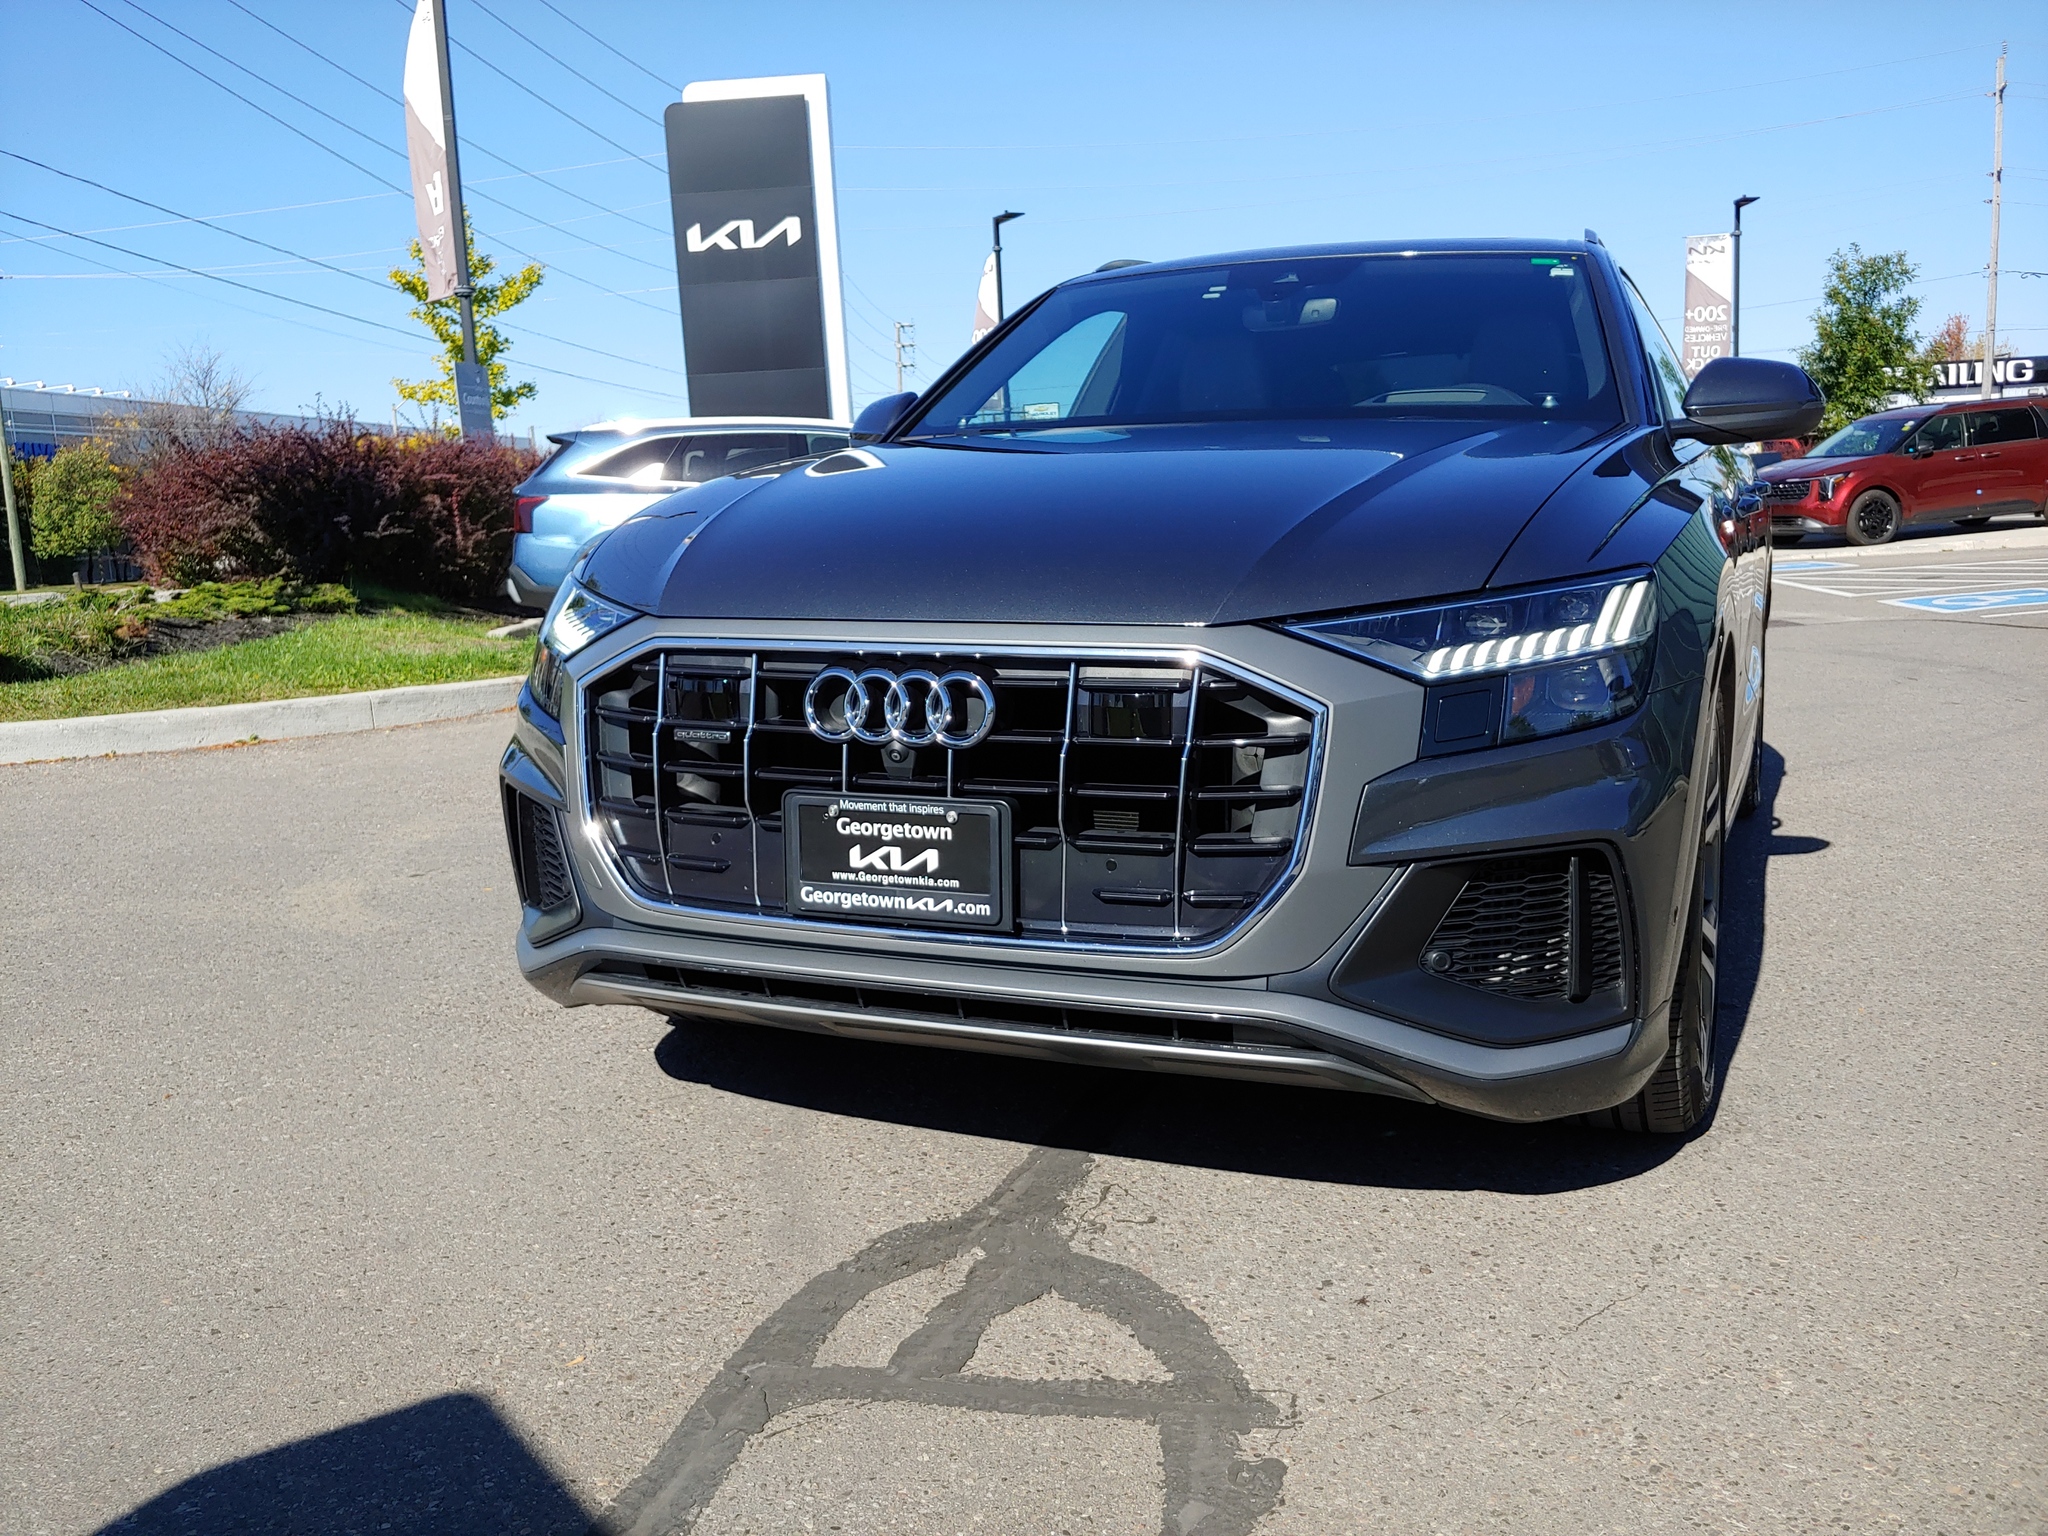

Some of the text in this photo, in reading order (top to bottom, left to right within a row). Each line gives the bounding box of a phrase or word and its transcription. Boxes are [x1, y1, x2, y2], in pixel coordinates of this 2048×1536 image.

[686, 215, 802, 253] KIA
[676, 731, 727, 740] quattro
[840, 800, 945, 815] Movement that inspires
[836, 817, 953, 840] Georgetown
[849, 843, 939, 873] KIA
[831, 871, 960, 888] www.Georgetownkia.com
